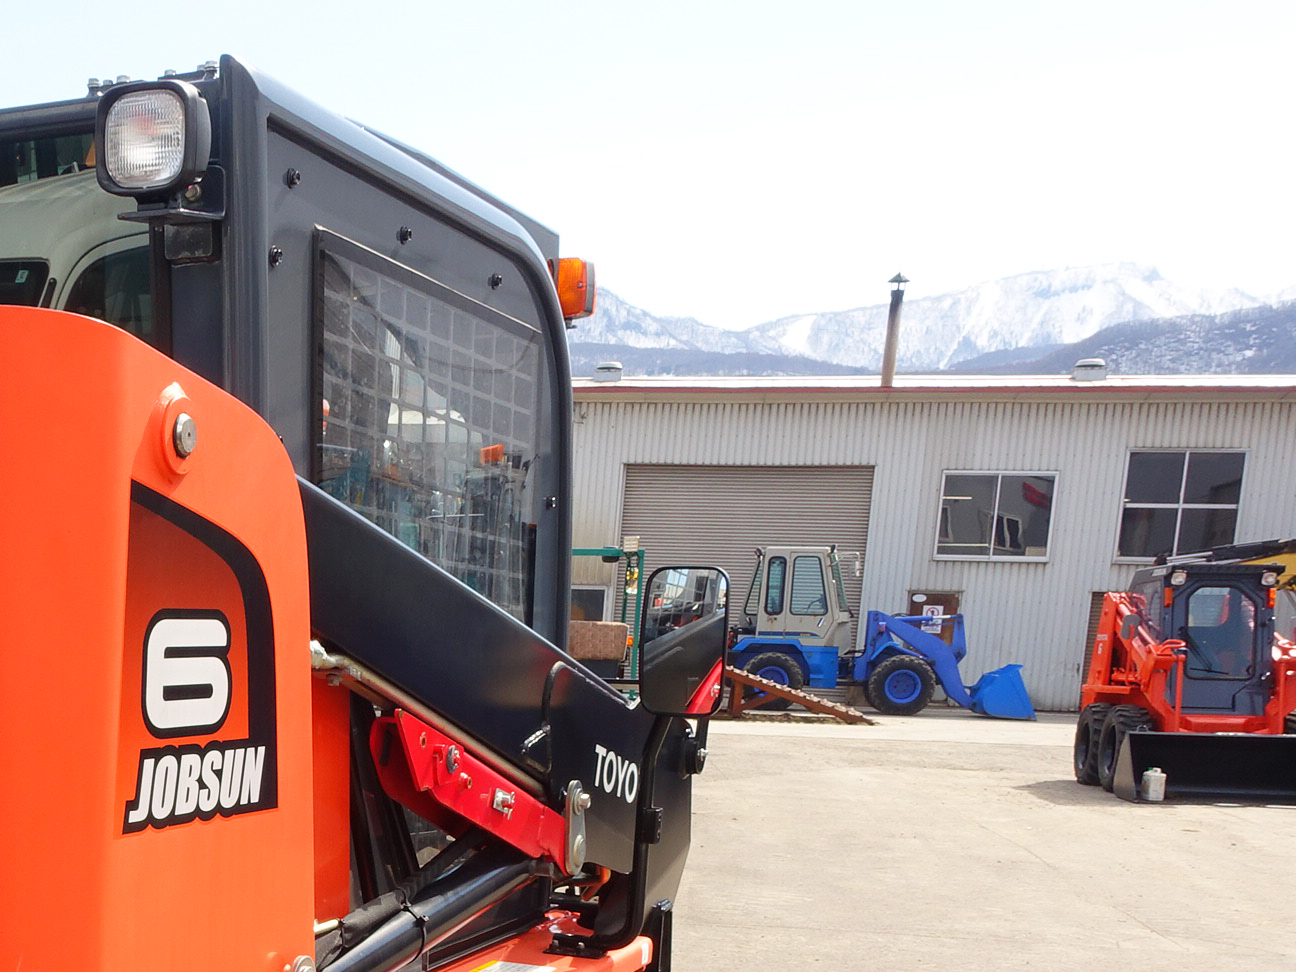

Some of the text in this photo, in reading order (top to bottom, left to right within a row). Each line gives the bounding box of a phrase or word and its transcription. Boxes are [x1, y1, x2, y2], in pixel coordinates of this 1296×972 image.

[146, 618, 229, 730] 6
[128, 745, 266, 824] JOBSUN
[594, 743, 640, 804] TOYO
